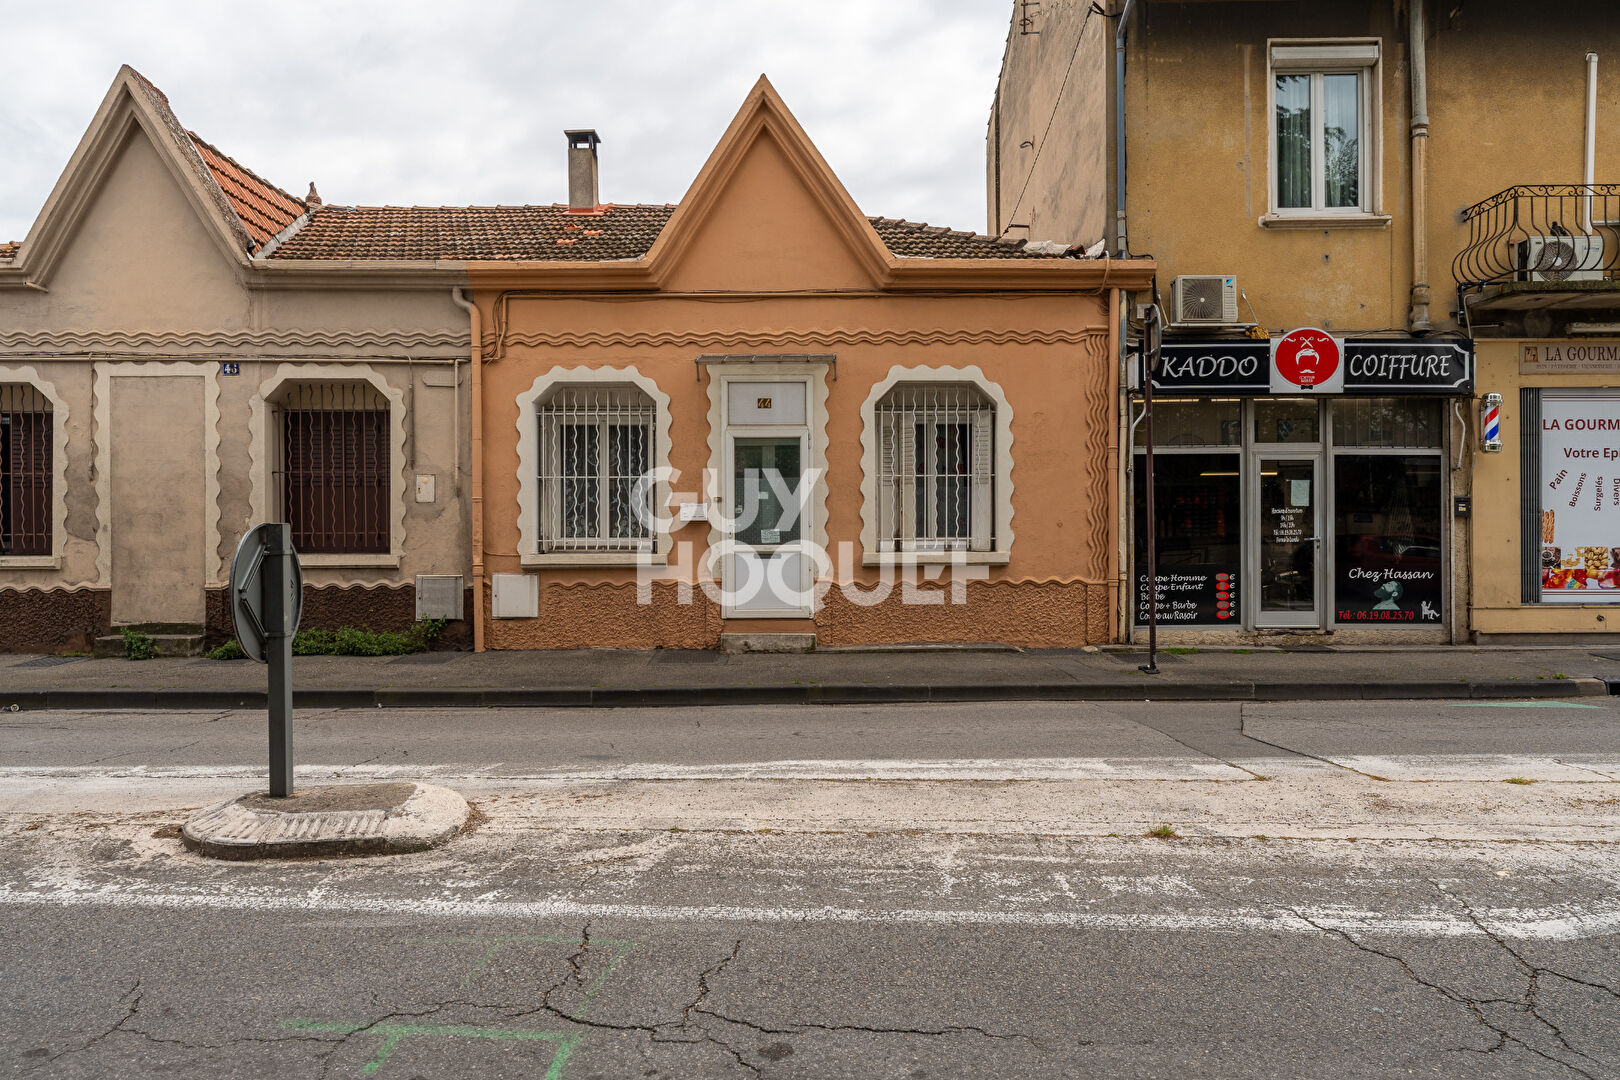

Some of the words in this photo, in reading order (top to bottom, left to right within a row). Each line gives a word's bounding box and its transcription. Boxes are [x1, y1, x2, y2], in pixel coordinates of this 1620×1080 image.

[1545, 346, 1562, 361] LA
[1566, 346, 1620, 361] GOURM
[1161, 355, 1258, 378] KADDO
[1350, 354, 1452, 380] COIFFURE
[1542, 419, 1560, 430] LA
[1563, 447, 1600, 458] Votre
[1549, 469, 1568, 490] Pain
[1568, 472, 1587, 507] Boissons
[1593, 476, 1604, 511] Surgelés
[1170, 574, 1208, 582] Homme
[1348, 567, 1383, 582] Chez
[1383, 568, 1434, 580] Hassan
[1170, 582, 1204, 591] Enfant
[1140, 591, 1166, 600] Babe
[1140, 601, 1165, 612] Cope
[1172, 600, 1197, 609] Barbe
[1357, 610, 1415, 621] 06.19.08.25.70
